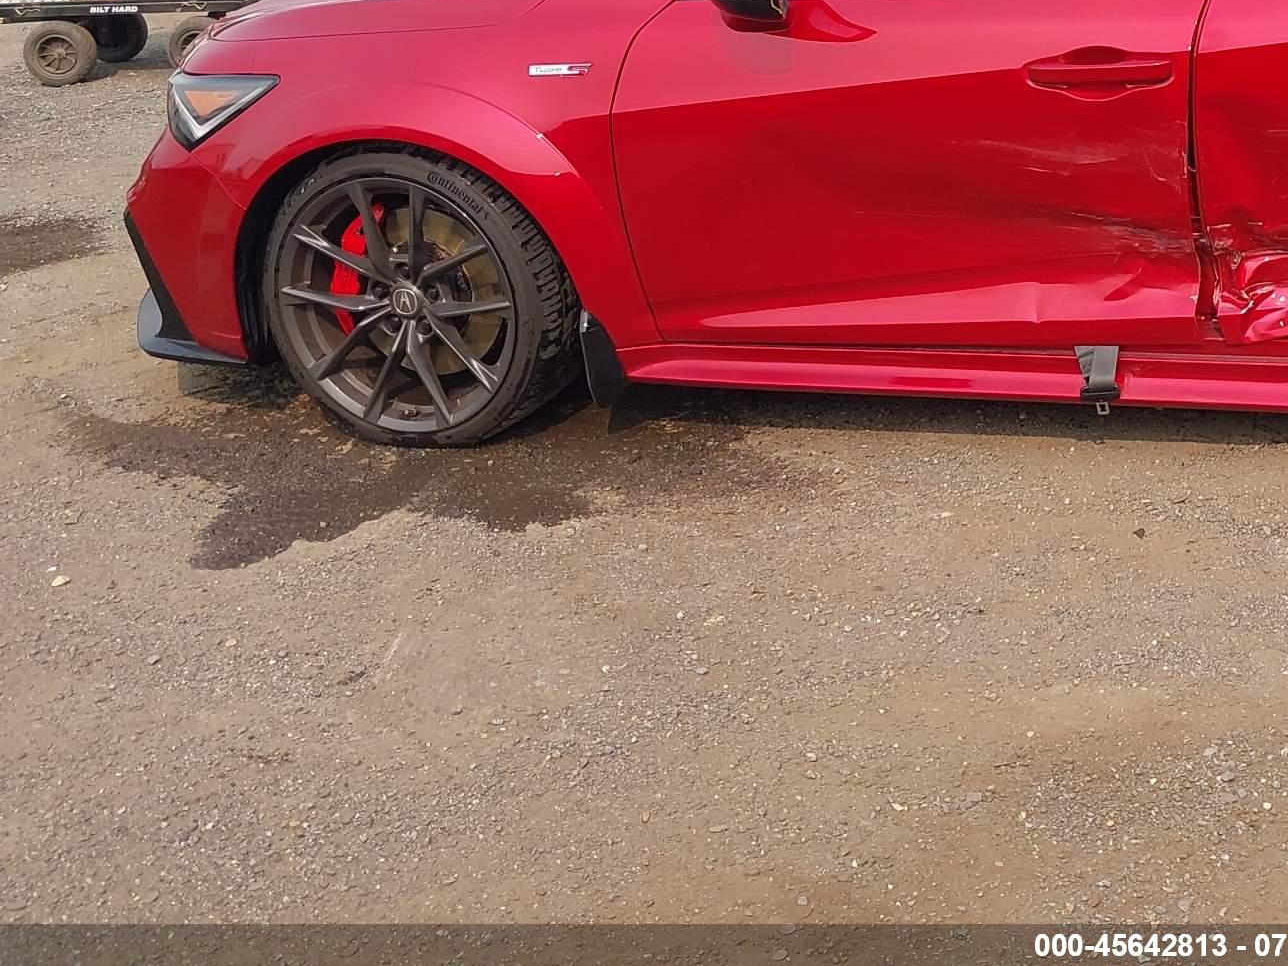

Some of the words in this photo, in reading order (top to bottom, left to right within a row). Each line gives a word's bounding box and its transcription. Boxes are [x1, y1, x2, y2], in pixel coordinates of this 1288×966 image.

[89, 6, 110, 14] BILT
[111, 5, 139, 13] HARD
[426, 171, 485, 215] Continental
